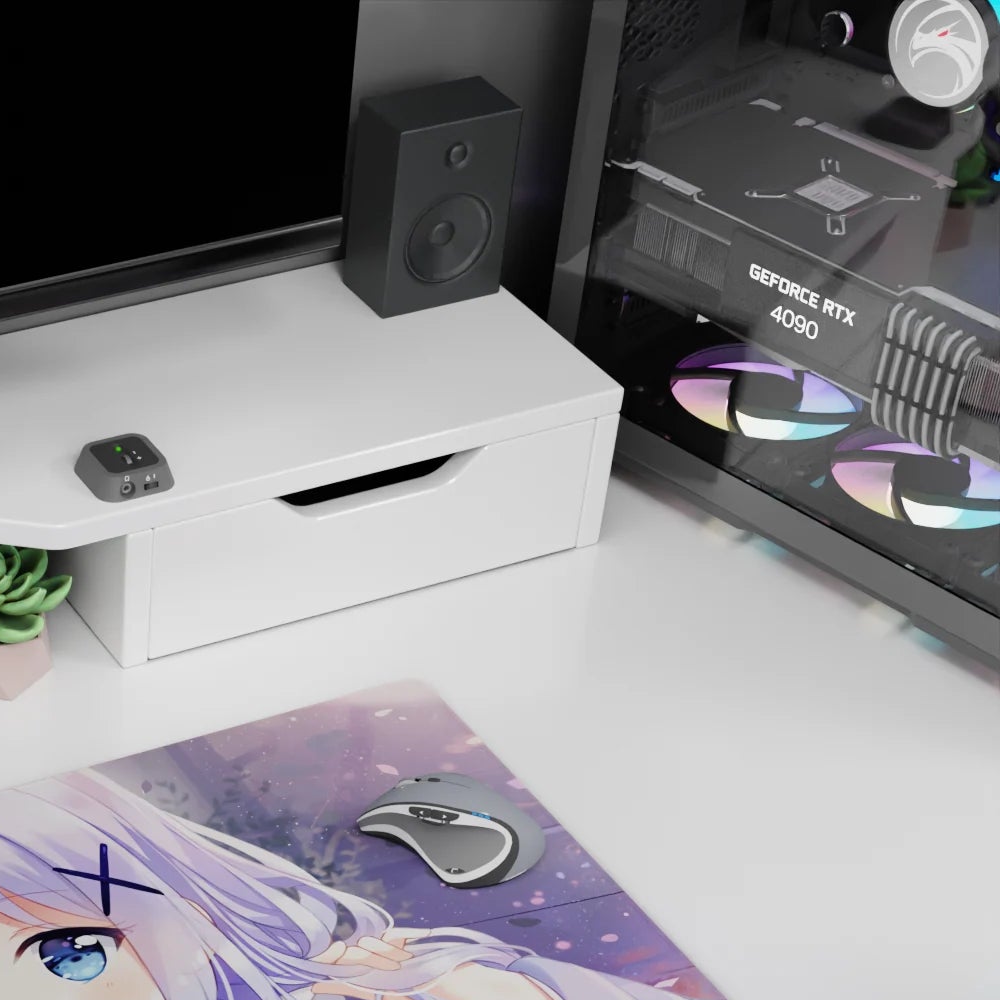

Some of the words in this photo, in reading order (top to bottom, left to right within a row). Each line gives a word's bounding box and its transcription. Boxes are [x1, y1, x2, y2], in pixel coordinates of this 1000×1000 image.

[749, 263, 820, 309] GEFORCE
[822, 298, 857, 327] RTX
[770, 305, 819, 340] 4090
